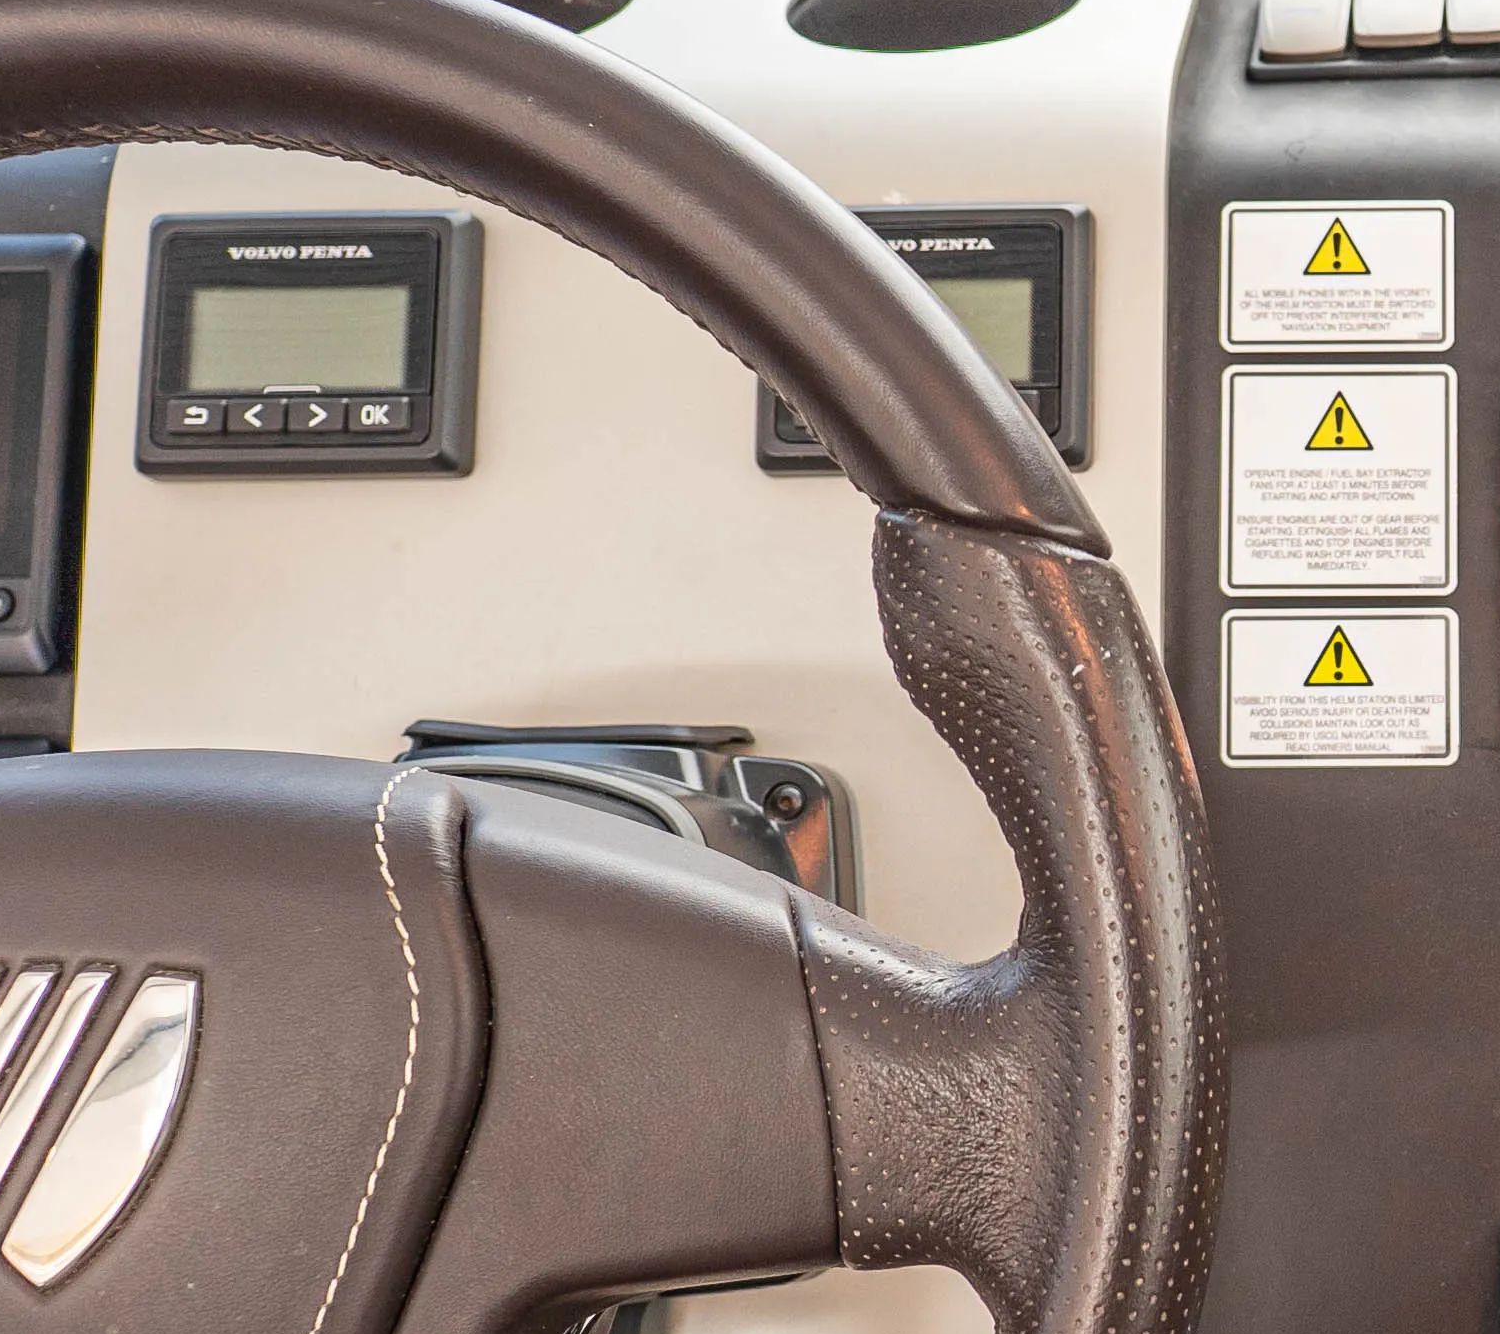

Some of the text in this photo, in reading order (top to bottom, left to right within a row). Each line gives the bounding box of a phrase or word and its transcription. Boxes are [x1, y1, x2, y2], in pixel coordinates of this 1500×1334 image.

[920, 238, 995, 251] PENTA
[228, 245, 373, 260] VOLVO PENTA
[1245, 289, 1431, 298] ALL MOBILE PHONES WITH IN THE VICINITY
[1240, 300, 1435, 309] OF THE HELM POSITION MUST BE SWITCHED
[1251, 312, 1424, 320] OFF TO PREVENT INTERFERENCE WITH
[1282, 323, 1336, 331] NAVIGATION
[360, 402, 390, 427] OK
[1244, 469, 1285, 478] OPERATE
[1290, 469, 1323, 478] ENGINE
[1331, 469, 1353, 478] FUEL
[1356, 469, 1373, 478] BAY
[1376, 469, 1431, 478] EXTRACTOR
[1250, 481, 1273, 489] FANS
[1276, 481, 1293, 489] FOR
[1297, 481, 1308, 489] AT
[1312, 481, 1339, 489] LEAST
[1349, 481, 1389, 489] MINUTES
[1392, 481, 1427, 489] BEFORE
[1261, 492, 1306, 501] STARTING
[1309, 492, 1327, 501] AND
[1330, 492, 1359, 501] AFTER
[1237, 515, 1439, 524] ENSURE ENGINES ARE OUT OF GEAR BEFORE
[1298, 527, 1351, 535] EXTINGUISH
[1356, 527, 1371, 535] ALL
[1374, 527, 1408, 535] FLAMES
[1412, 527, 1430, 535] AND
[1245, 538, 1431, 547] CIGARETTES AND STOP ENGINES BEFORE
[1306, 550, 1331, 558] WASH
[1334, 550, 1351, 558] OFF
[1356, 550, 1372, 558] ANY
[1403, 550, 1424, 558] FUEL
[1234, 696, 1277, 704] VISIBILITY
[1280, 696, 1305, 704] FROM
[1308, 696, 1327, 704] THIS
[1330, 696, 1355, 704] HELM
[1357, 696, 1395, 704] STATION
[1399, 696, 1406, 704] IS
[1250, 707, 1430, 716] AVOID SERIOUS INJURY OR DEATH FROM
[1260, 719, 1420, 728] COLLISIONS MAINTAIN LOOK OUT AS
[1250, 731, 1296, 740] REQUIRED
[1299, 731, 1310, 740] BY
[1341, 731, 1395, 740] NAVIGATION
[1286, 743, 1309, 751] READ
